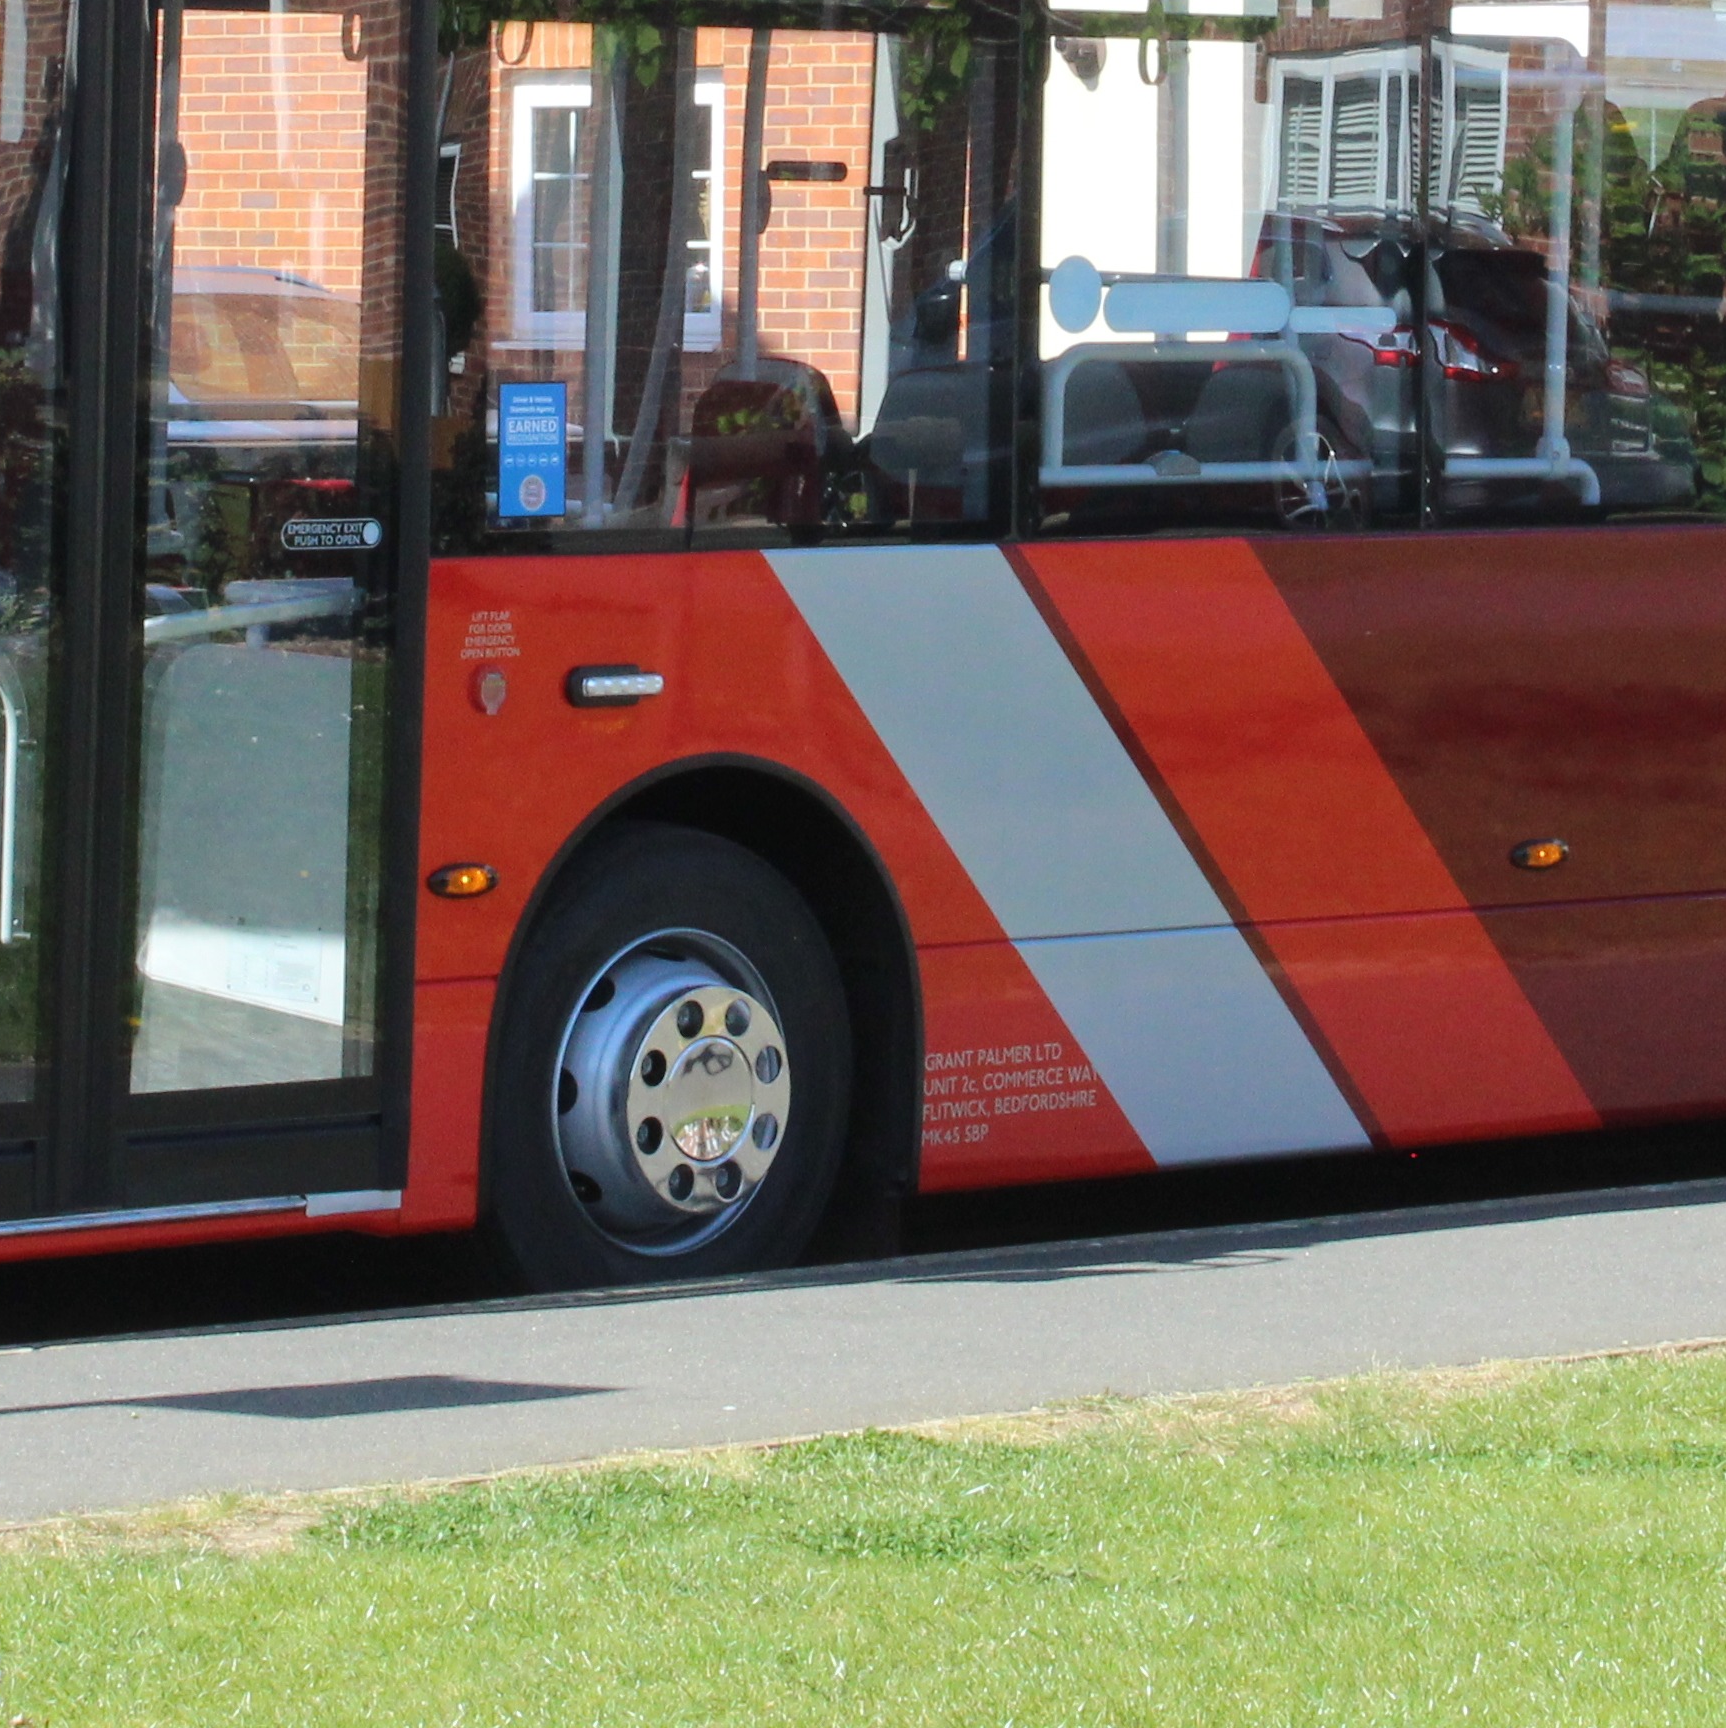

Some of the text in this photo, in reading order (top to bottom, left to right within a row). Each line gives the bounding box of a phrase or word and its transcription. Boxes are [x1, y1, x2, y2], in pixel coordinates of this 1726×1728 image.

[508, 419, 557, 433] EARNED
[287, 522, 364, 535] EMERGENCY EXIT
[294, 534, 361, 546] PUSH TO OPEN
[924, 1042, 1062, 1071] GRANT PALMER LTD
[923, 1076, 959, 1097] UNIT
[982, 1067, 1064, 1091] COMMERCE
[922, 1089, 1097, 1122] FLITWICK, BEDFORDSHIRE
